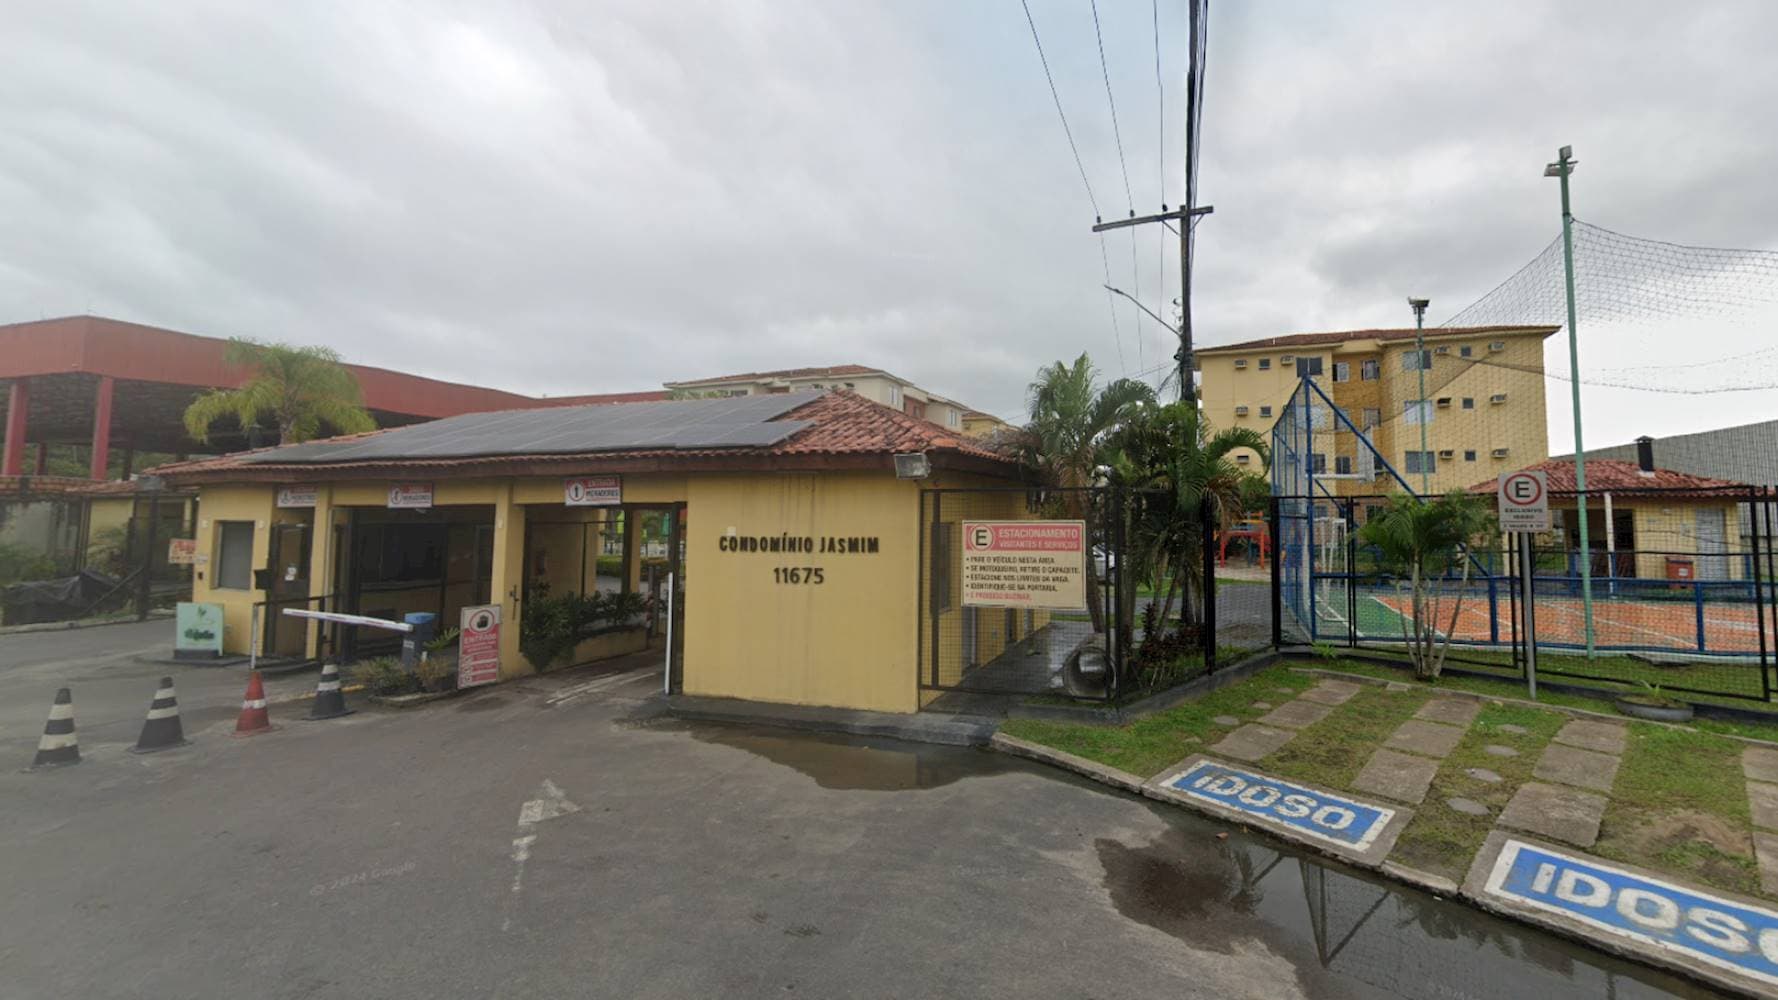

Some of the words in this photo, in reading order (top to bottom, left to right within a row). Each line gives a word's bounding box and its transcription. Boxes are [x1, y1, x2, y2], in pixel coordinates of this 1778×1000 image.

[1515, 481, 1530, 498] E
[976, 529, 987, 546] E
[999, 528, 1079, 539] ESTACIONAMENTO
[719, 532, 813, 553] CONDOMÍNIO
[819, 536, 879, 553] JASMIM
[773, 567, 824, 584] 11675
[1192, 775, 1356, 830] IDOSO
